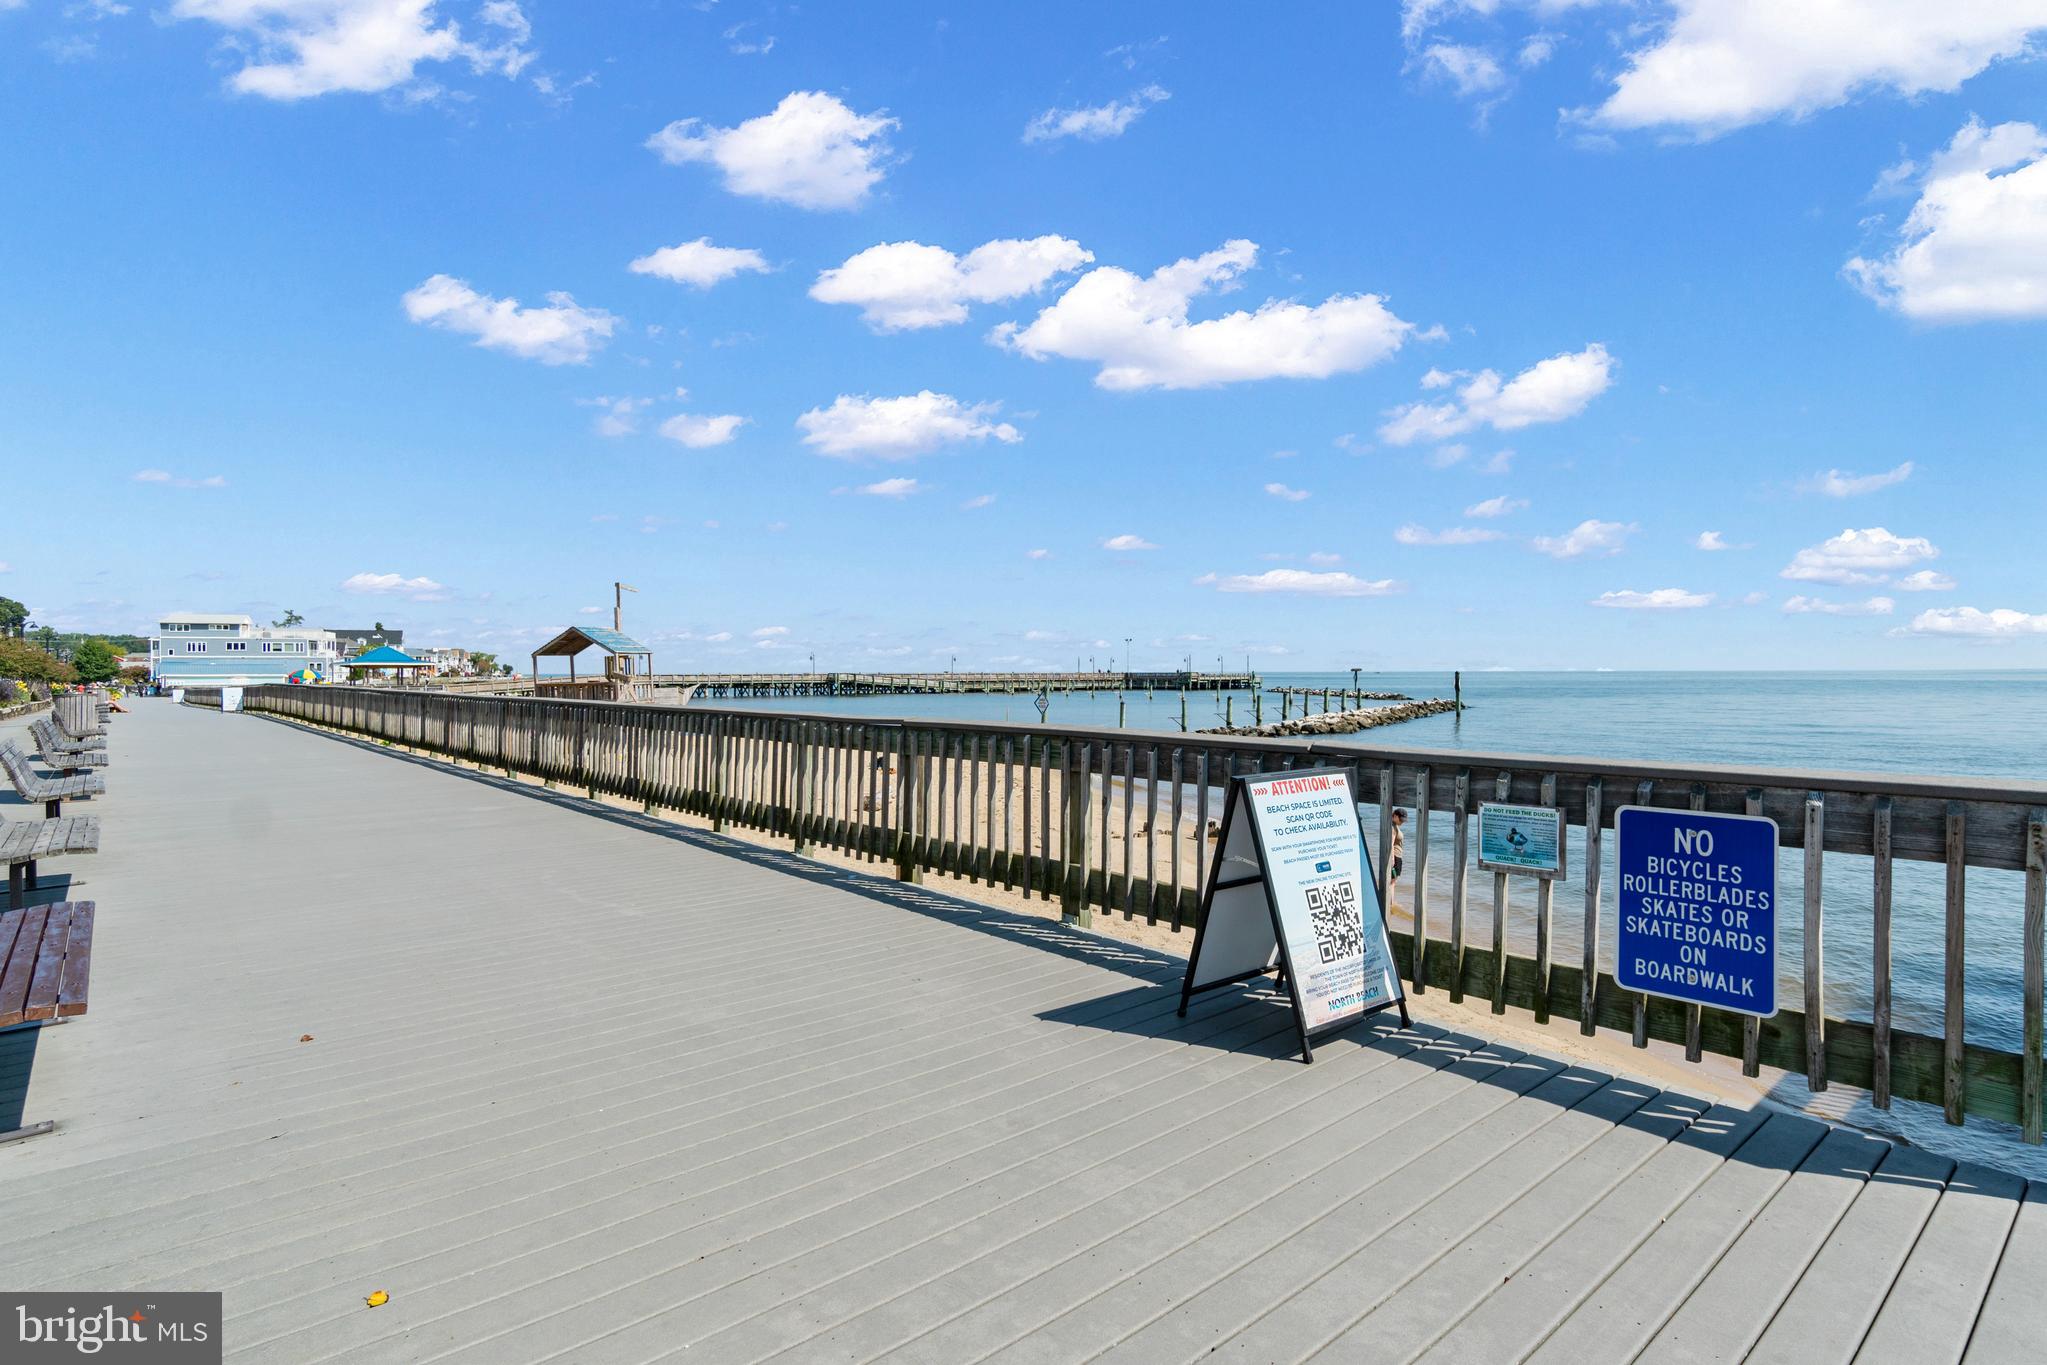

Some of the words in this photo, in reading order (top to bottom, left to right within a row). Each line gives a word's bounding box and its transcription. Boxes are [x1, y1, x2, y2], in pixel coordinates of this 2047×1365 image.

[1272, 777, 1330, 795] ATTENTION!
[1267, 804, 1290, 813] BEACH
[1291, 802, 1311, 810] SPACE
[1319, 798, 1343, 806] LIMITED.
[1286, 814, 1304, 823] SCAN
[1315, 810, 1332, 819] CODE
[1274, 828, 1283, 836] TO
[1284, 825, 1307, 834] CHECK
[1308, 819, 1348, 831] AVAILABILITY.
[1674, 827, 1714, 857] NO
[1648, 856, 1742, 884] BICYCLES
[1624, 874, 1769, 910] ROLLERBLADES
[1642, 897, 1713, 924] SKATES
[1722, 909, 1749, 929] OR
[1626, 916, 1766, 954] SKATEBOARDS
[1680, 946, 1706, 966] ON
[1635, 958, 1754, 997] BOARDWALK
[1328, 994, 1354, 1011] NORTH
[1356, 986, 1378, 1001] BEACH
